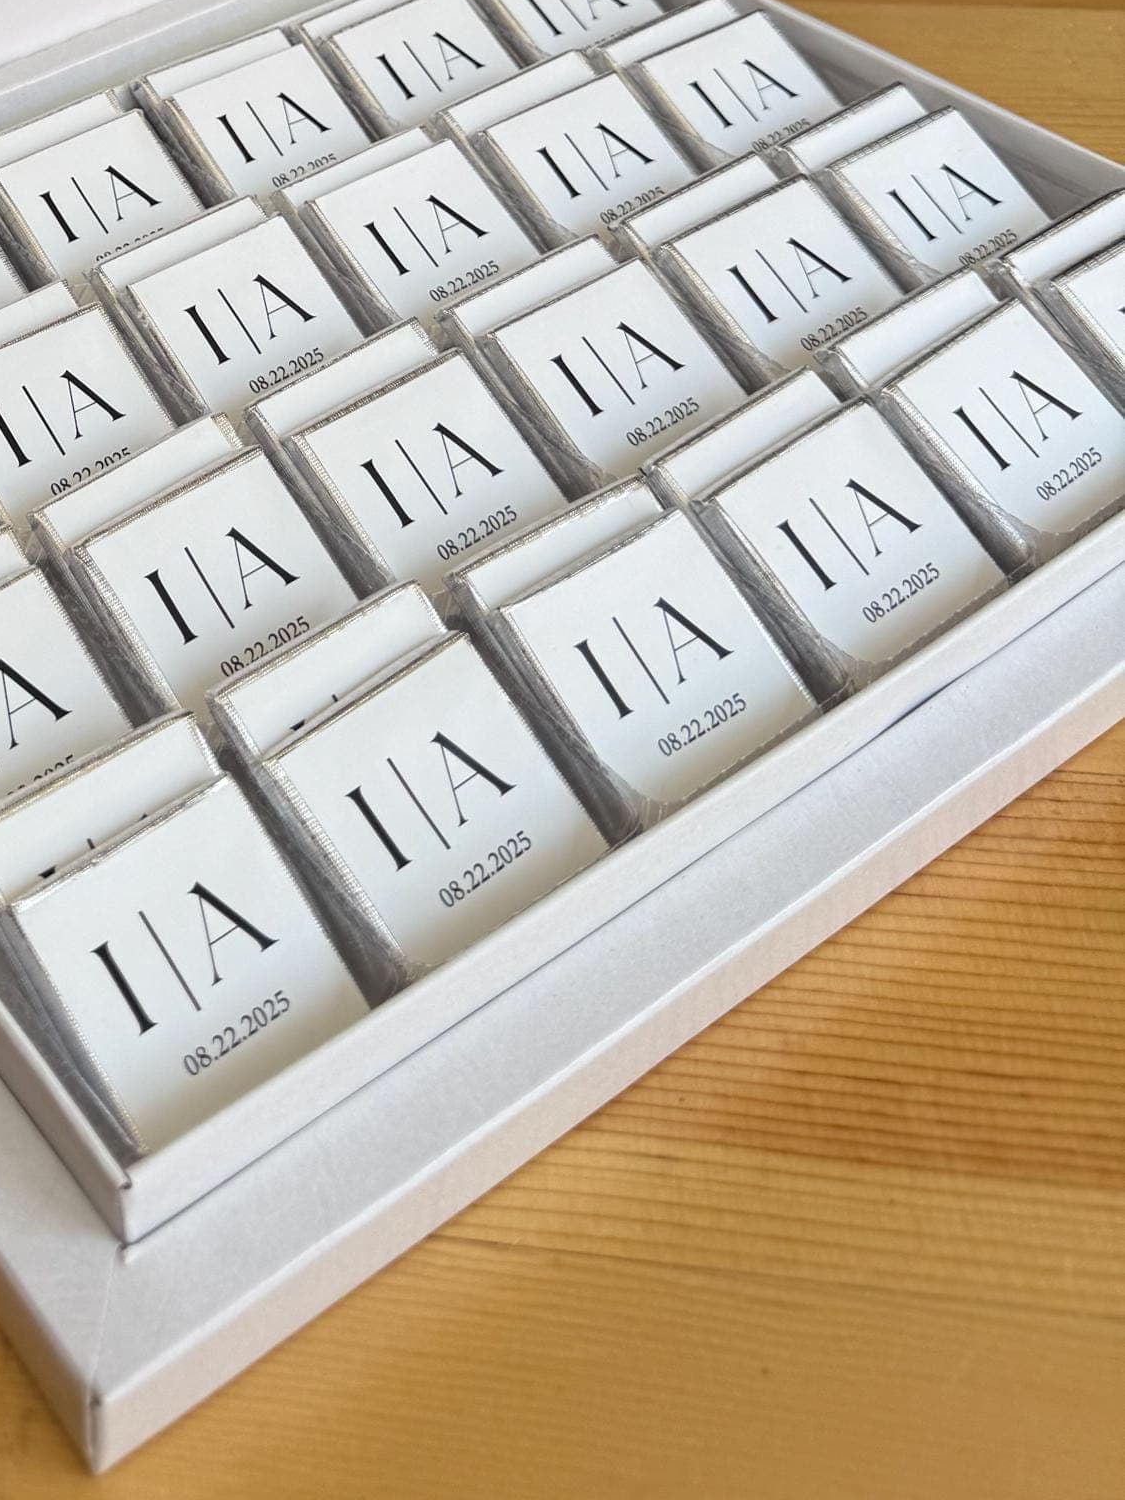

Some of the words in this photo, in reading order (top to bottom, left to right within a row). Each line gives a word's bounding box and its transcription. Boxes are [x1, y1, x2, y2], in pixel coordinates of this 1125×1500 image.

[958, 228, 1018, 267] 08.22.2025
[429, 260, 500, 303] 08.22.2025
[800, 306, 867, 351] 08.22.2025
[249, 347, 324, 394] 08.22.2025
[626, 398, 700, 446] 08.22.2025
[1036, 447, 1103, 501] 08.22.2025
[437, 505, 517, 560] 08.22.2025
[862, 562, 941, 623] 08.22.2025
[221, 616, 310, 678] 08.22.2025
[658, 693, 747, 757] 08.22.2025
[439, 831, 532, 908] 08.22.2025
[184, 991, 291, 1076] 08.22.2025
